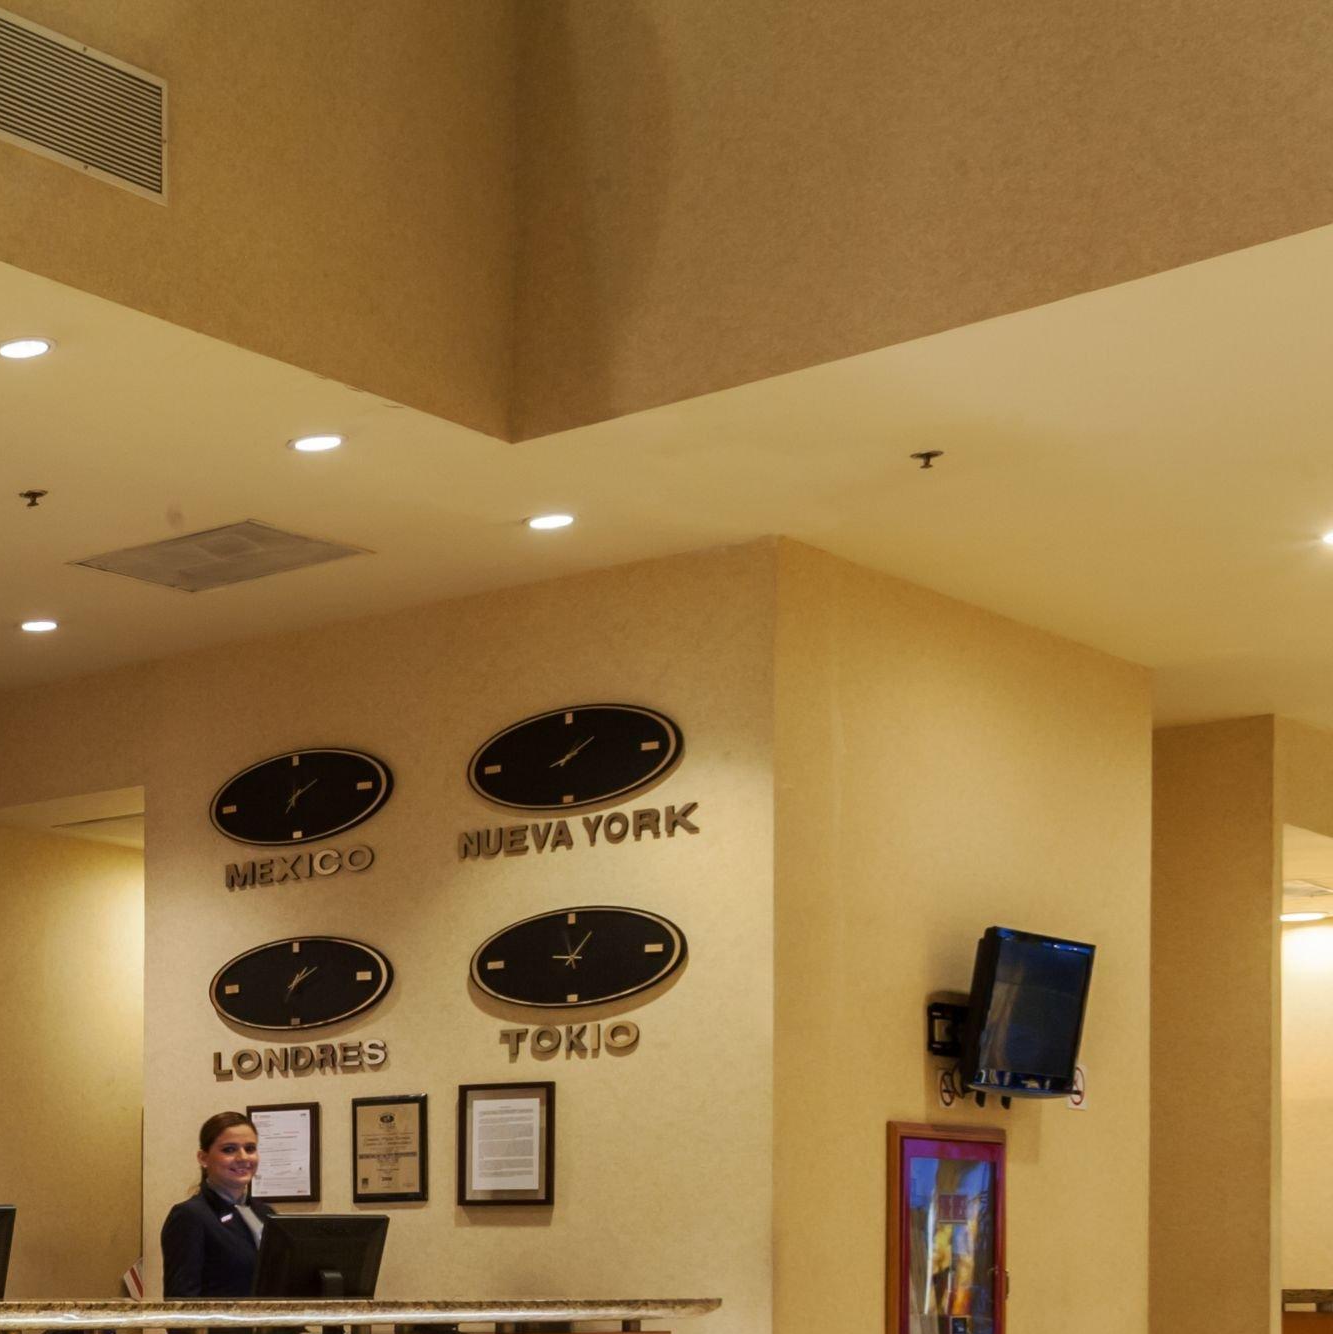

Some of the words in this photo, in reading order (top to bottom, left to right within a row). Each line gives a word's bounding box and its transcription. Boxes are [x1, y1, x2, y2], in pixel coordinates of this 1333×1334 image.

[458, 820, 573, 860] NUEVA
[583, 802, 700, 844] YORK
[225, 844, 375, 892] MEXICO
[213, 1039, 387, 1081] LONDRES
[499, 1021, 641, 1063] TOKIO
